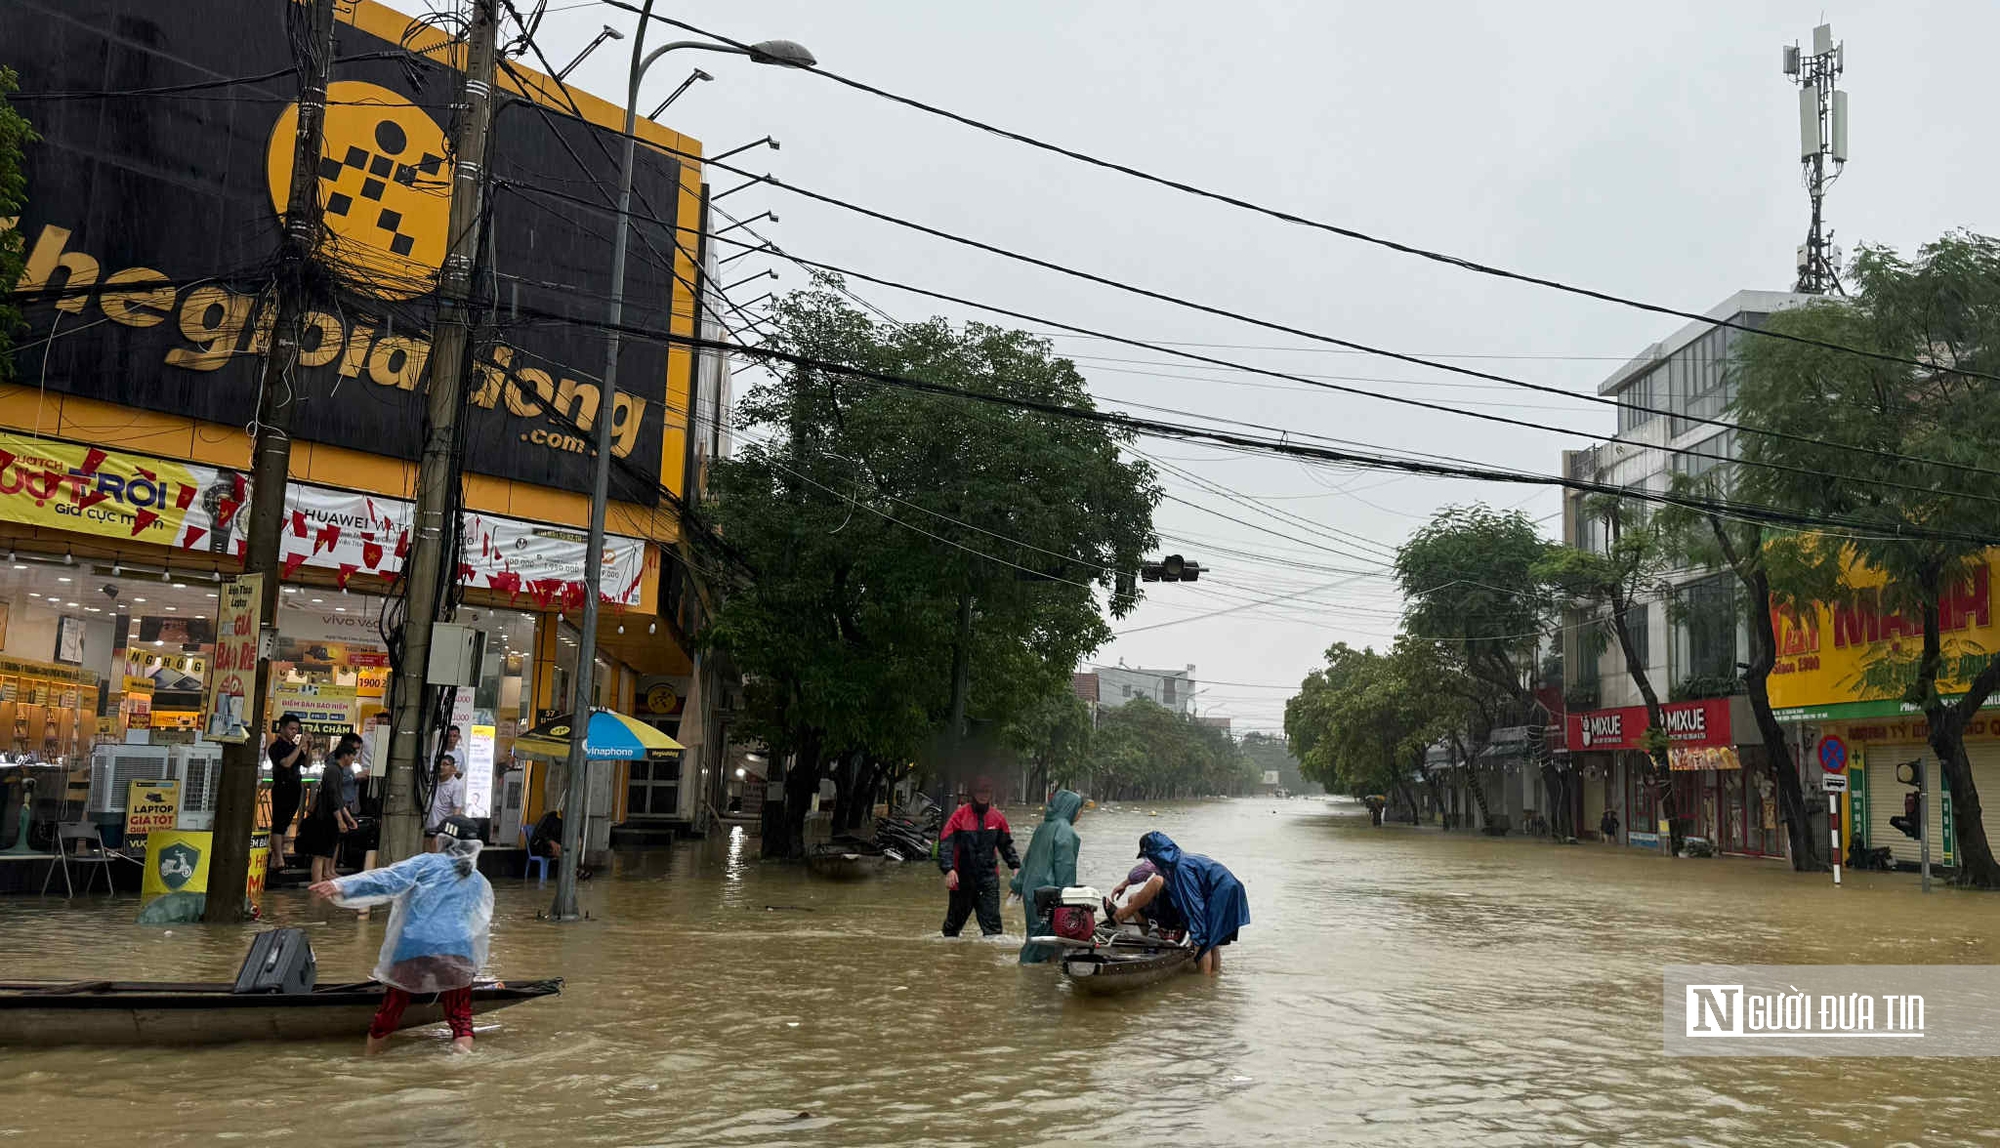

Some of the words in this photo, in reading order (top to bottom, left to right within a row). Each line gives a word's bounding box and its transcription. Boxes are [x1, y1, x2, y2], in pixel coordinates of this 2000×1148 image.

[521, 428, 598, 456] .com
[305, 508, 369, 529] HUAWEI
[234, 610, 253, 637] GIÁ
[322, 614, 355, 627] vivo
[359, 677, 380, 689] 1900
[1591, 715, 1621, 735] MIXUE
[1667, 708, 1705, 731] MIXUE
[587, 746, 633, 757] vinaphone
[134, 805, 173, 814] LAPTOP
